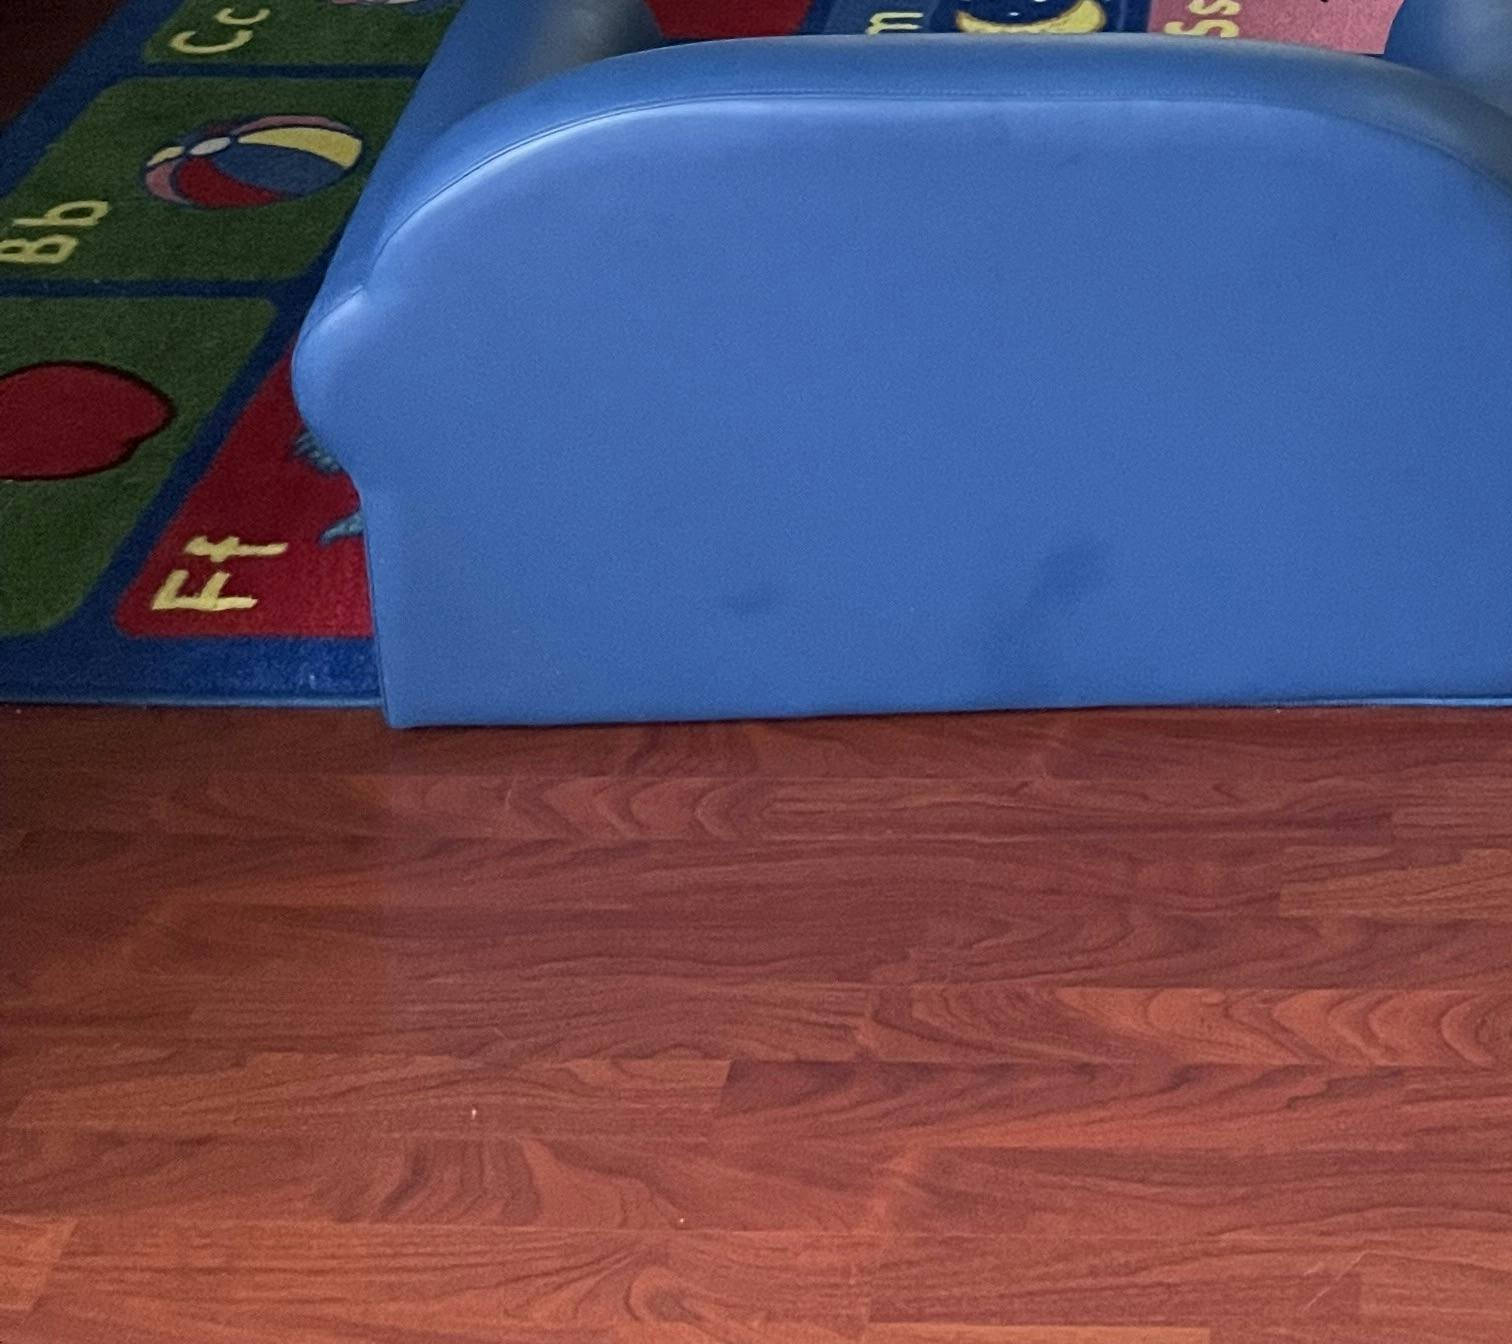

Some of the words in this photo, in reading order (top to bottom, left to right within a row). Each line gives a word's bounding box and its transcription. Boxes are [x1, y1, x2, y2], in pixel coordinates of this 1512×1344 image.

[169, 4, 271, 57] Cc
[0, 200, 109, 264] Bb
[149, 534, 289, 613] Ff
